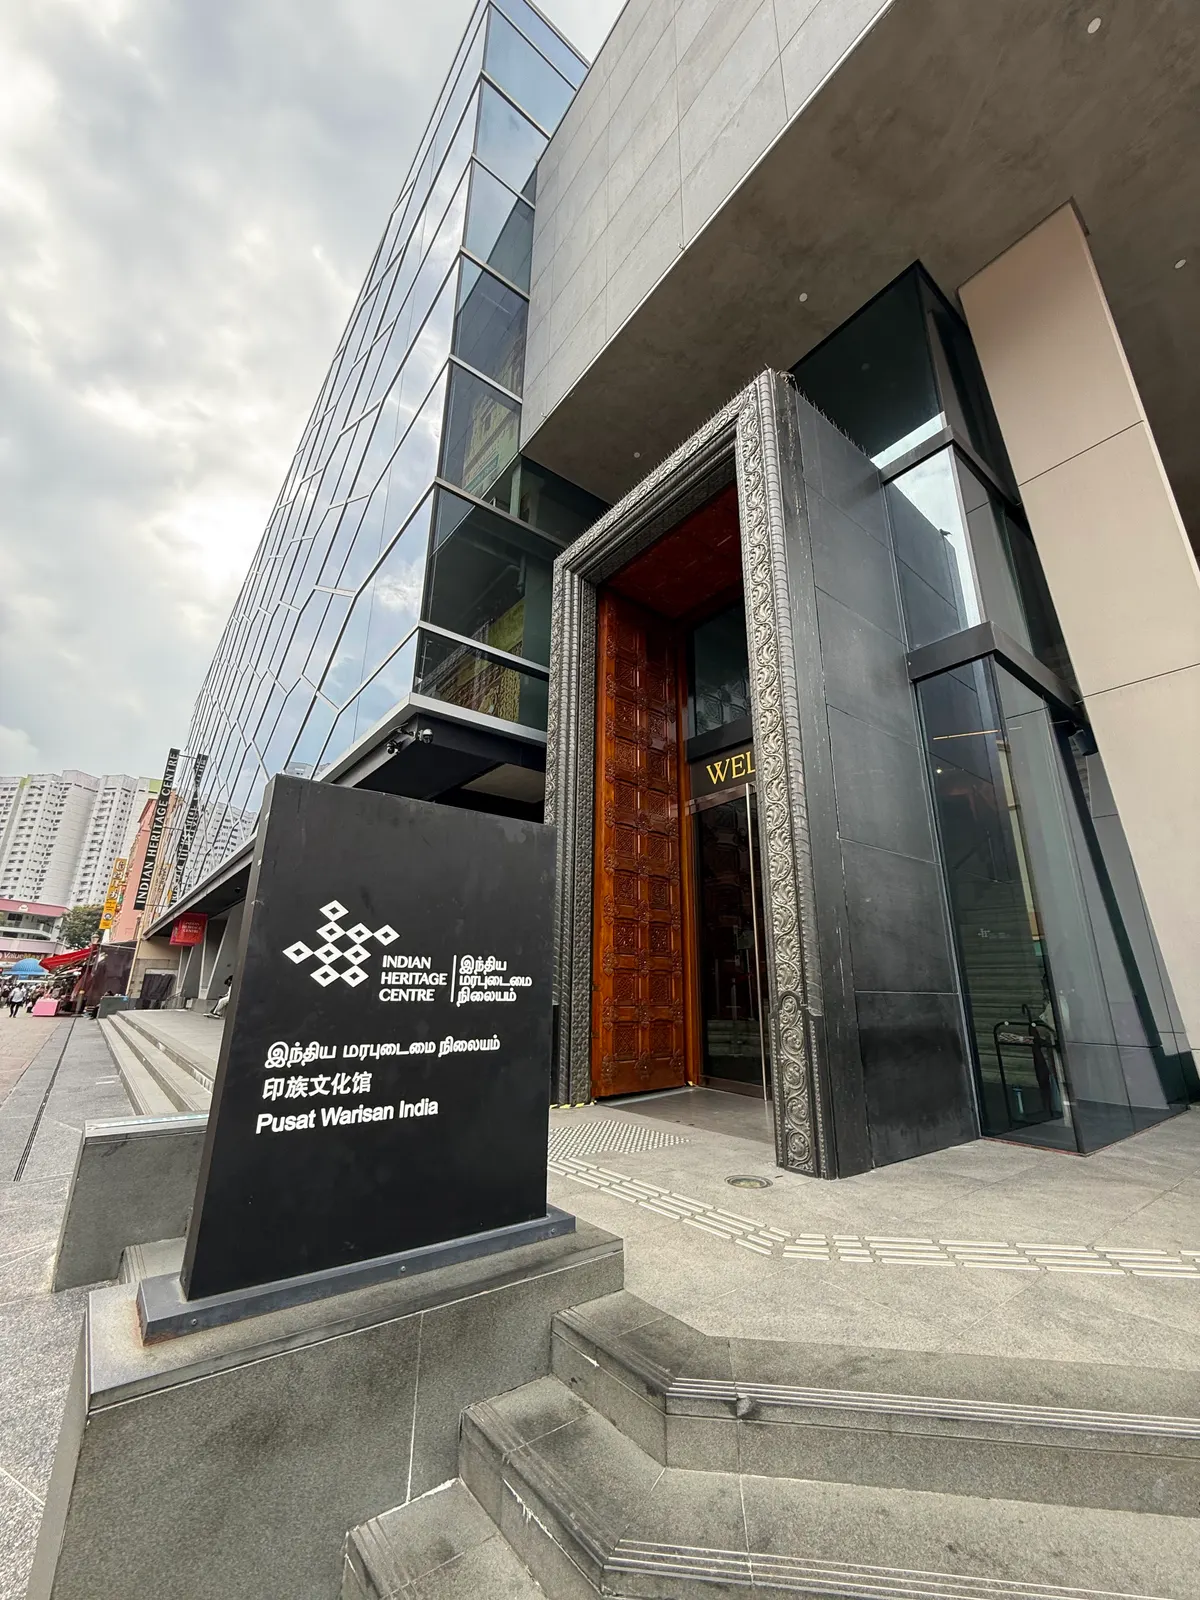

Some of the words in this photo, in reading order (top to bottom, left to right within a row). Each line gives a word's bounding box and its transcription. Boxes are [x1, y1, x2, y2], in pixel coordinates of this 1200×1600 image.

[136, 861, 155, 904] INDIAN
[147, 800, 168, 858] HERITAGE
[161, 752, 179, 796] CENTRE
[382, 955, 431, 969] INDIAN
[459, 954, 507, 975] இந்திய
[380, 972, 448, 986] HERITAGE
[459, 974, 533, 991] மரபுடைமை
[379, 988, 436, 1002] CENTRE
[457, 987, 517, 1007] நிலையம்
[264, 1041, 337, 1069] இந்திய
[343, 1041, 436, 1061] மரபுடைமை
[438, 1034, 501, 1057] நிலையம்
[262, 1071, 373, 1101] 印族文化馆
[255, 1108, 316, 1134] Pusat
[320, 1103, 394, 1127] Warisan
[399, 1097, 439, 1119] India
